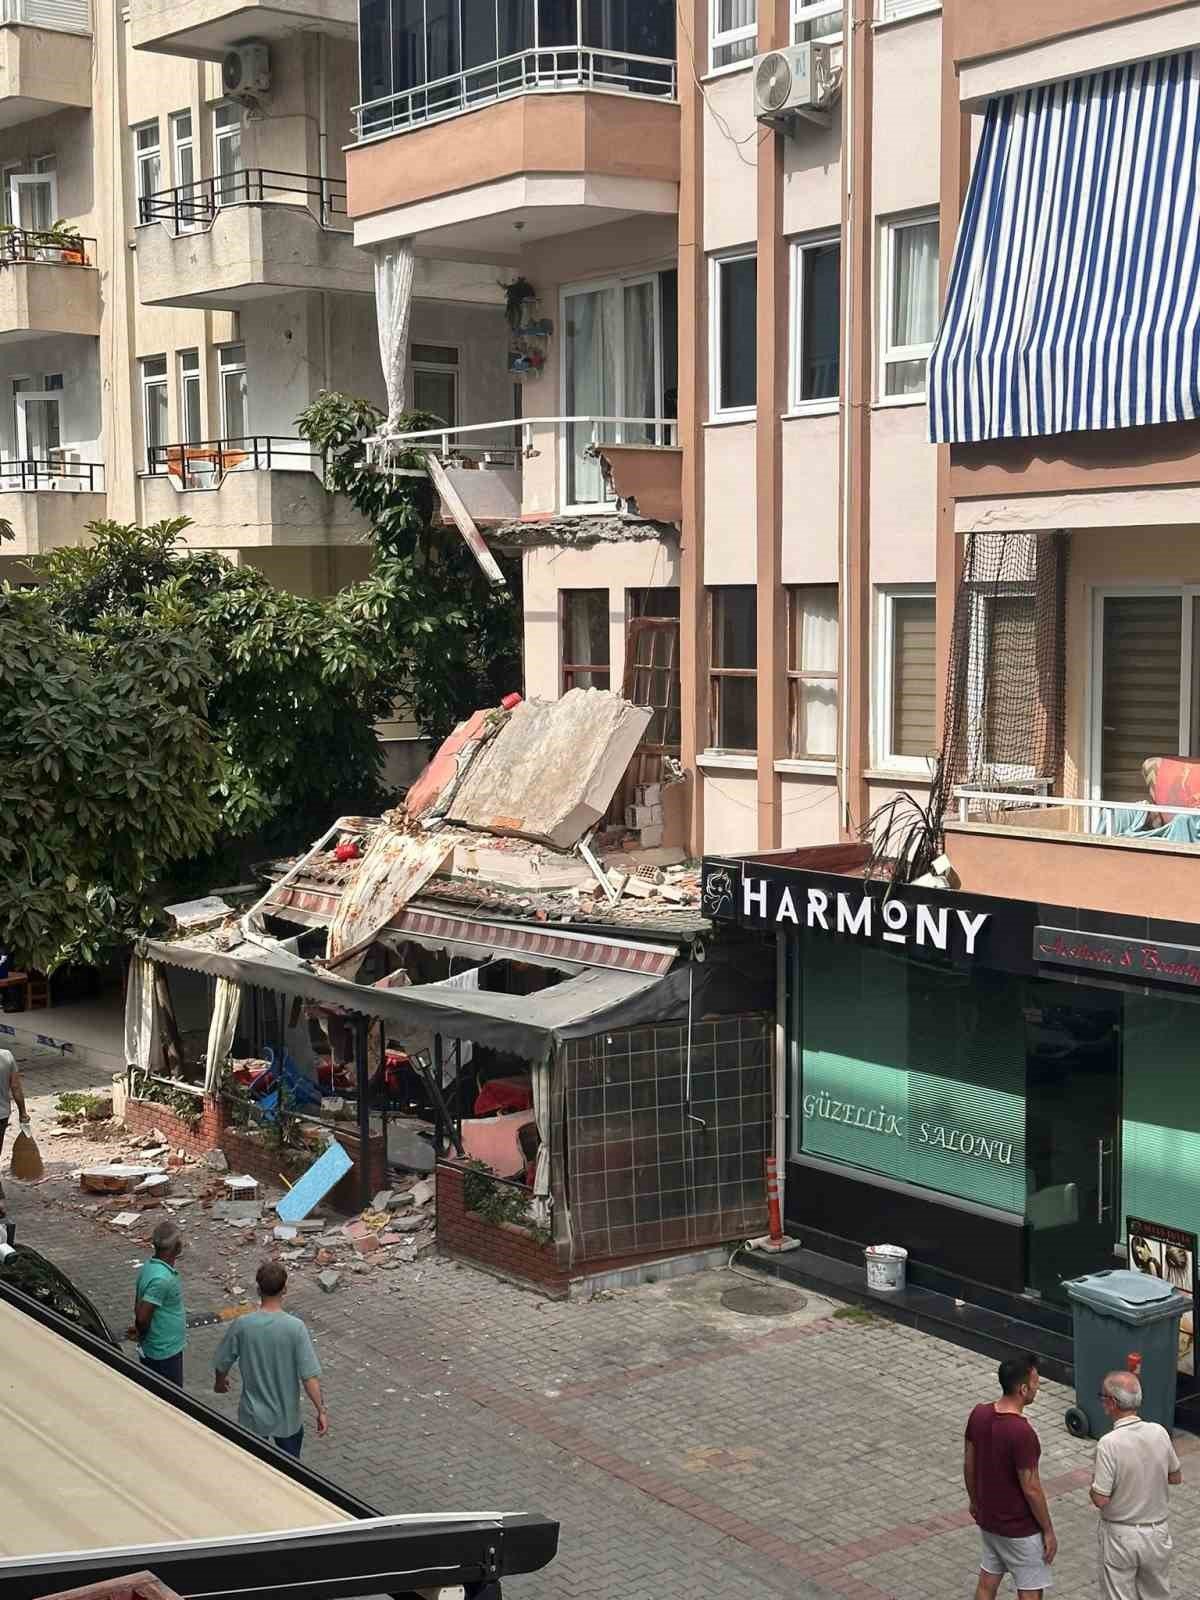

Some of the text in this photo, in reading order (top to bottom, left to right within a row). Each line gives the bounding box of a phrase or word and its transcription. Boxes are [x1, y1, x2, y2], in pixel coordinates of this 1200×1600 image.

[743, 877, 989, 954] HARMONY
[803, 1089, 1013, 1165] GÜZELLİK SALONU
